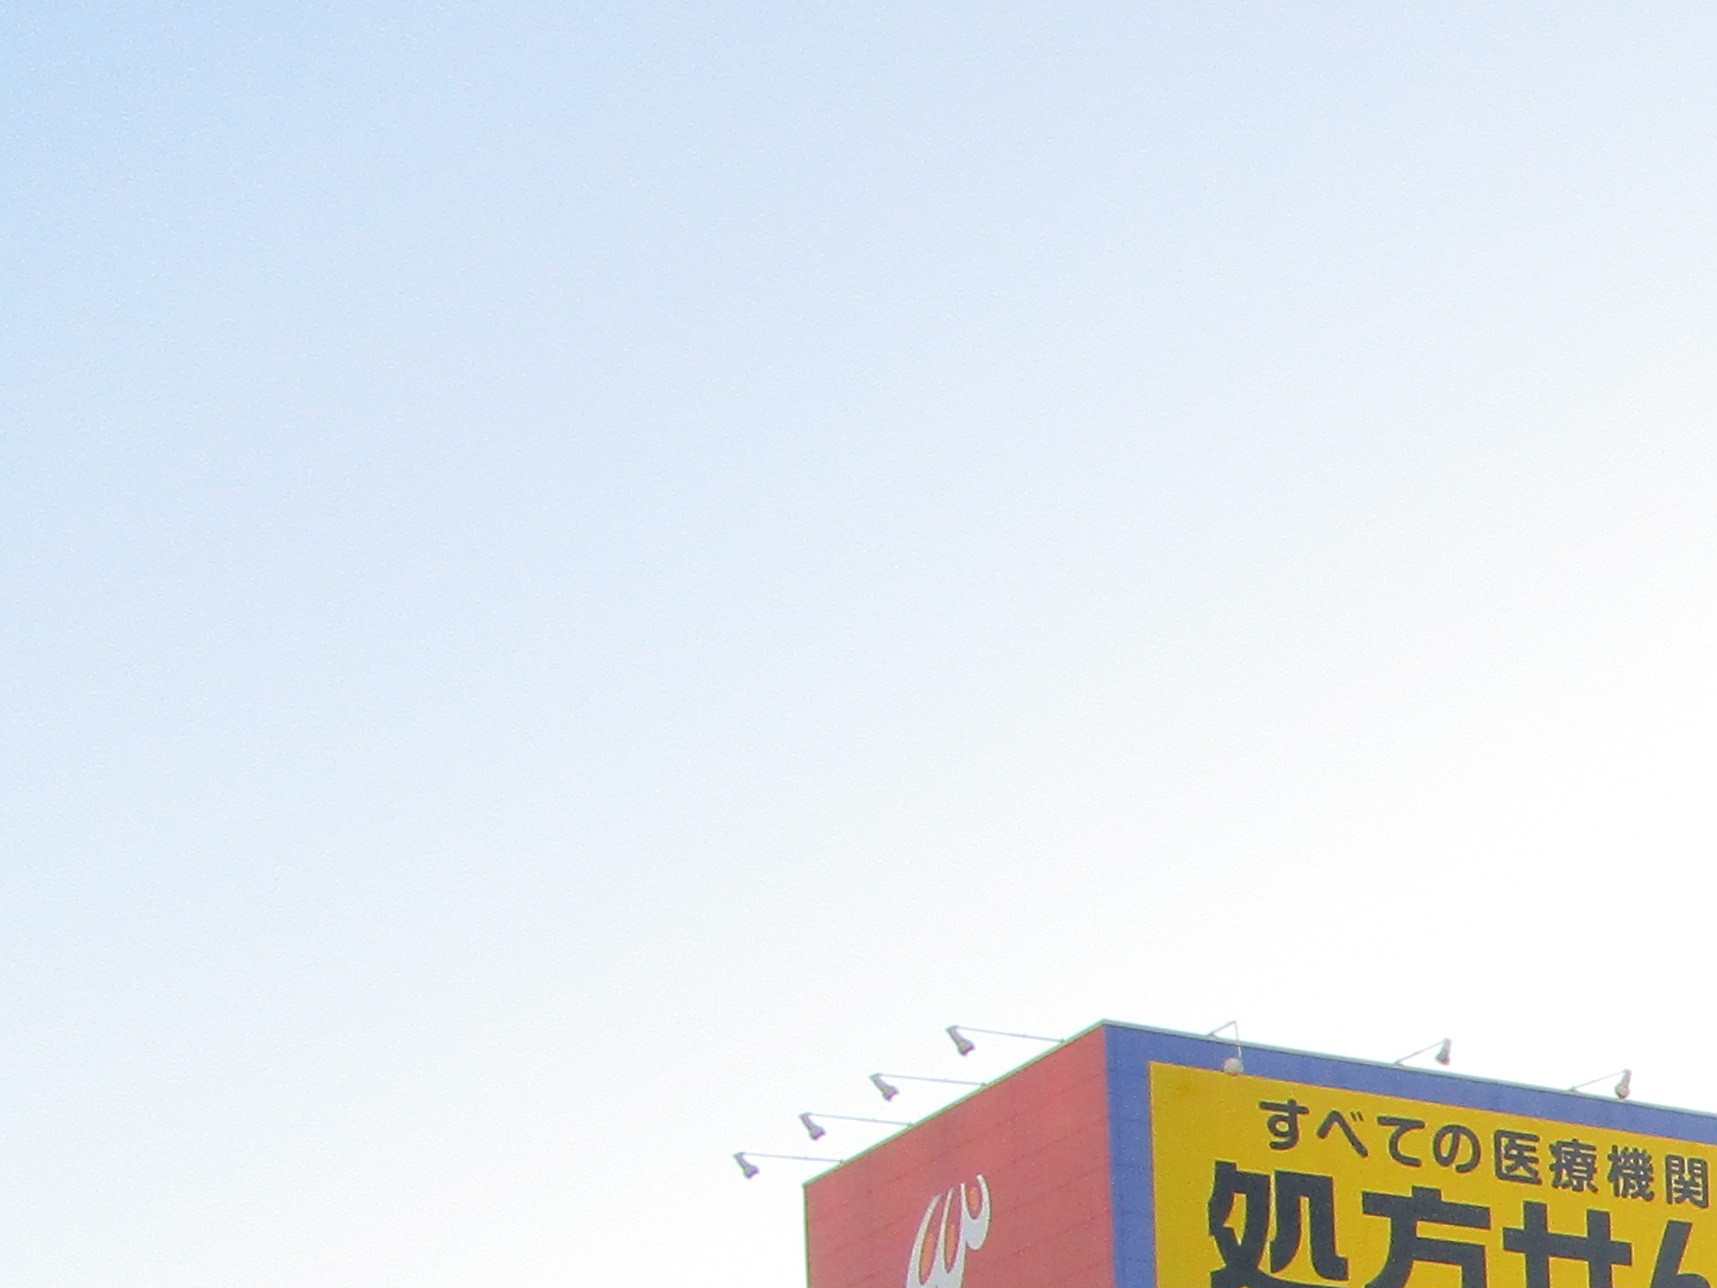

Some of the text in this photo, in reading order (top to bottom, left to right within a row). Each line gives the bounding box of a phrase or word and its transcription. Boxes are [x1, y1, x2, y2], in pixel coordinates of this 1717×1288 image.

[1259, 1097, 1710, 1209] すべての医療機関
